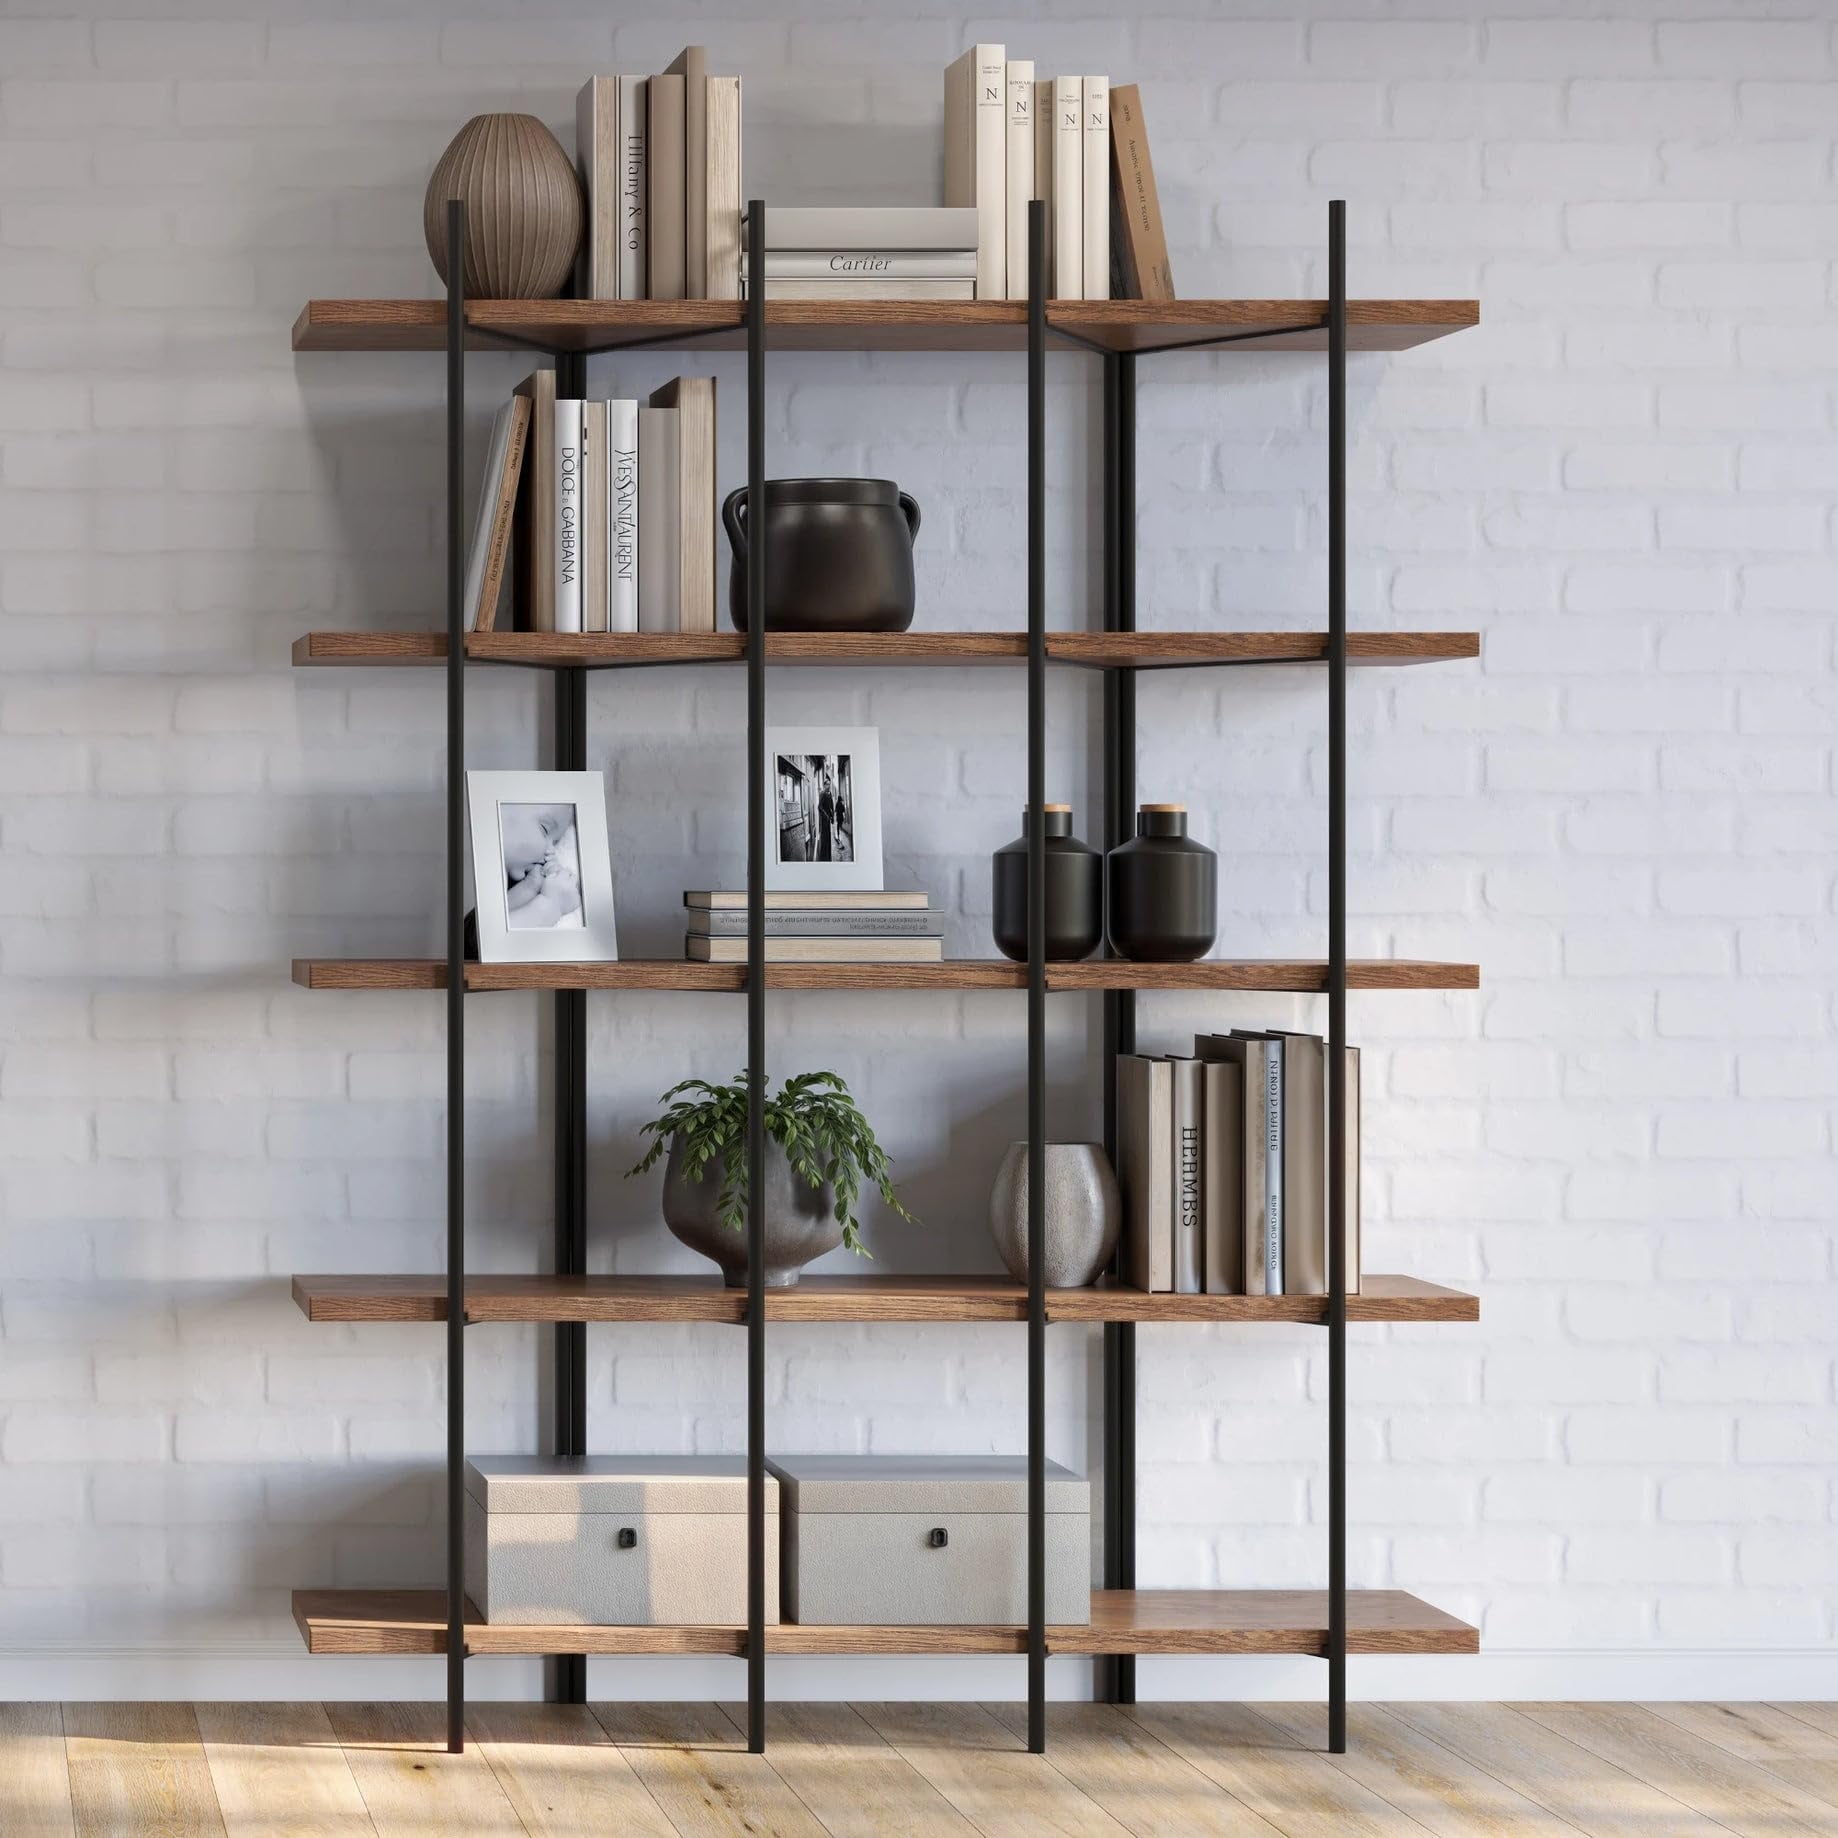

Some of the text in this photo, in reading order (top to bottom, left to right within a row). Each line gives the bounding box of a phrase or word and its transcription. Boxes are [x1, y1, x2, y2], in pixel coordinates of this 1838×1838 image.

[986, 87, 998, 100] N
[1015, 101, 1027, 113] N
[1064, 113, 1076, 125] N
[1091, 113, 1104, 125] N
[628, 226, 642, 250] Co
[829, 255, 892, 271] Cartier
[561, 447, 575, 495] DOLCE
[561, 506, 575, 585] GABBANA
